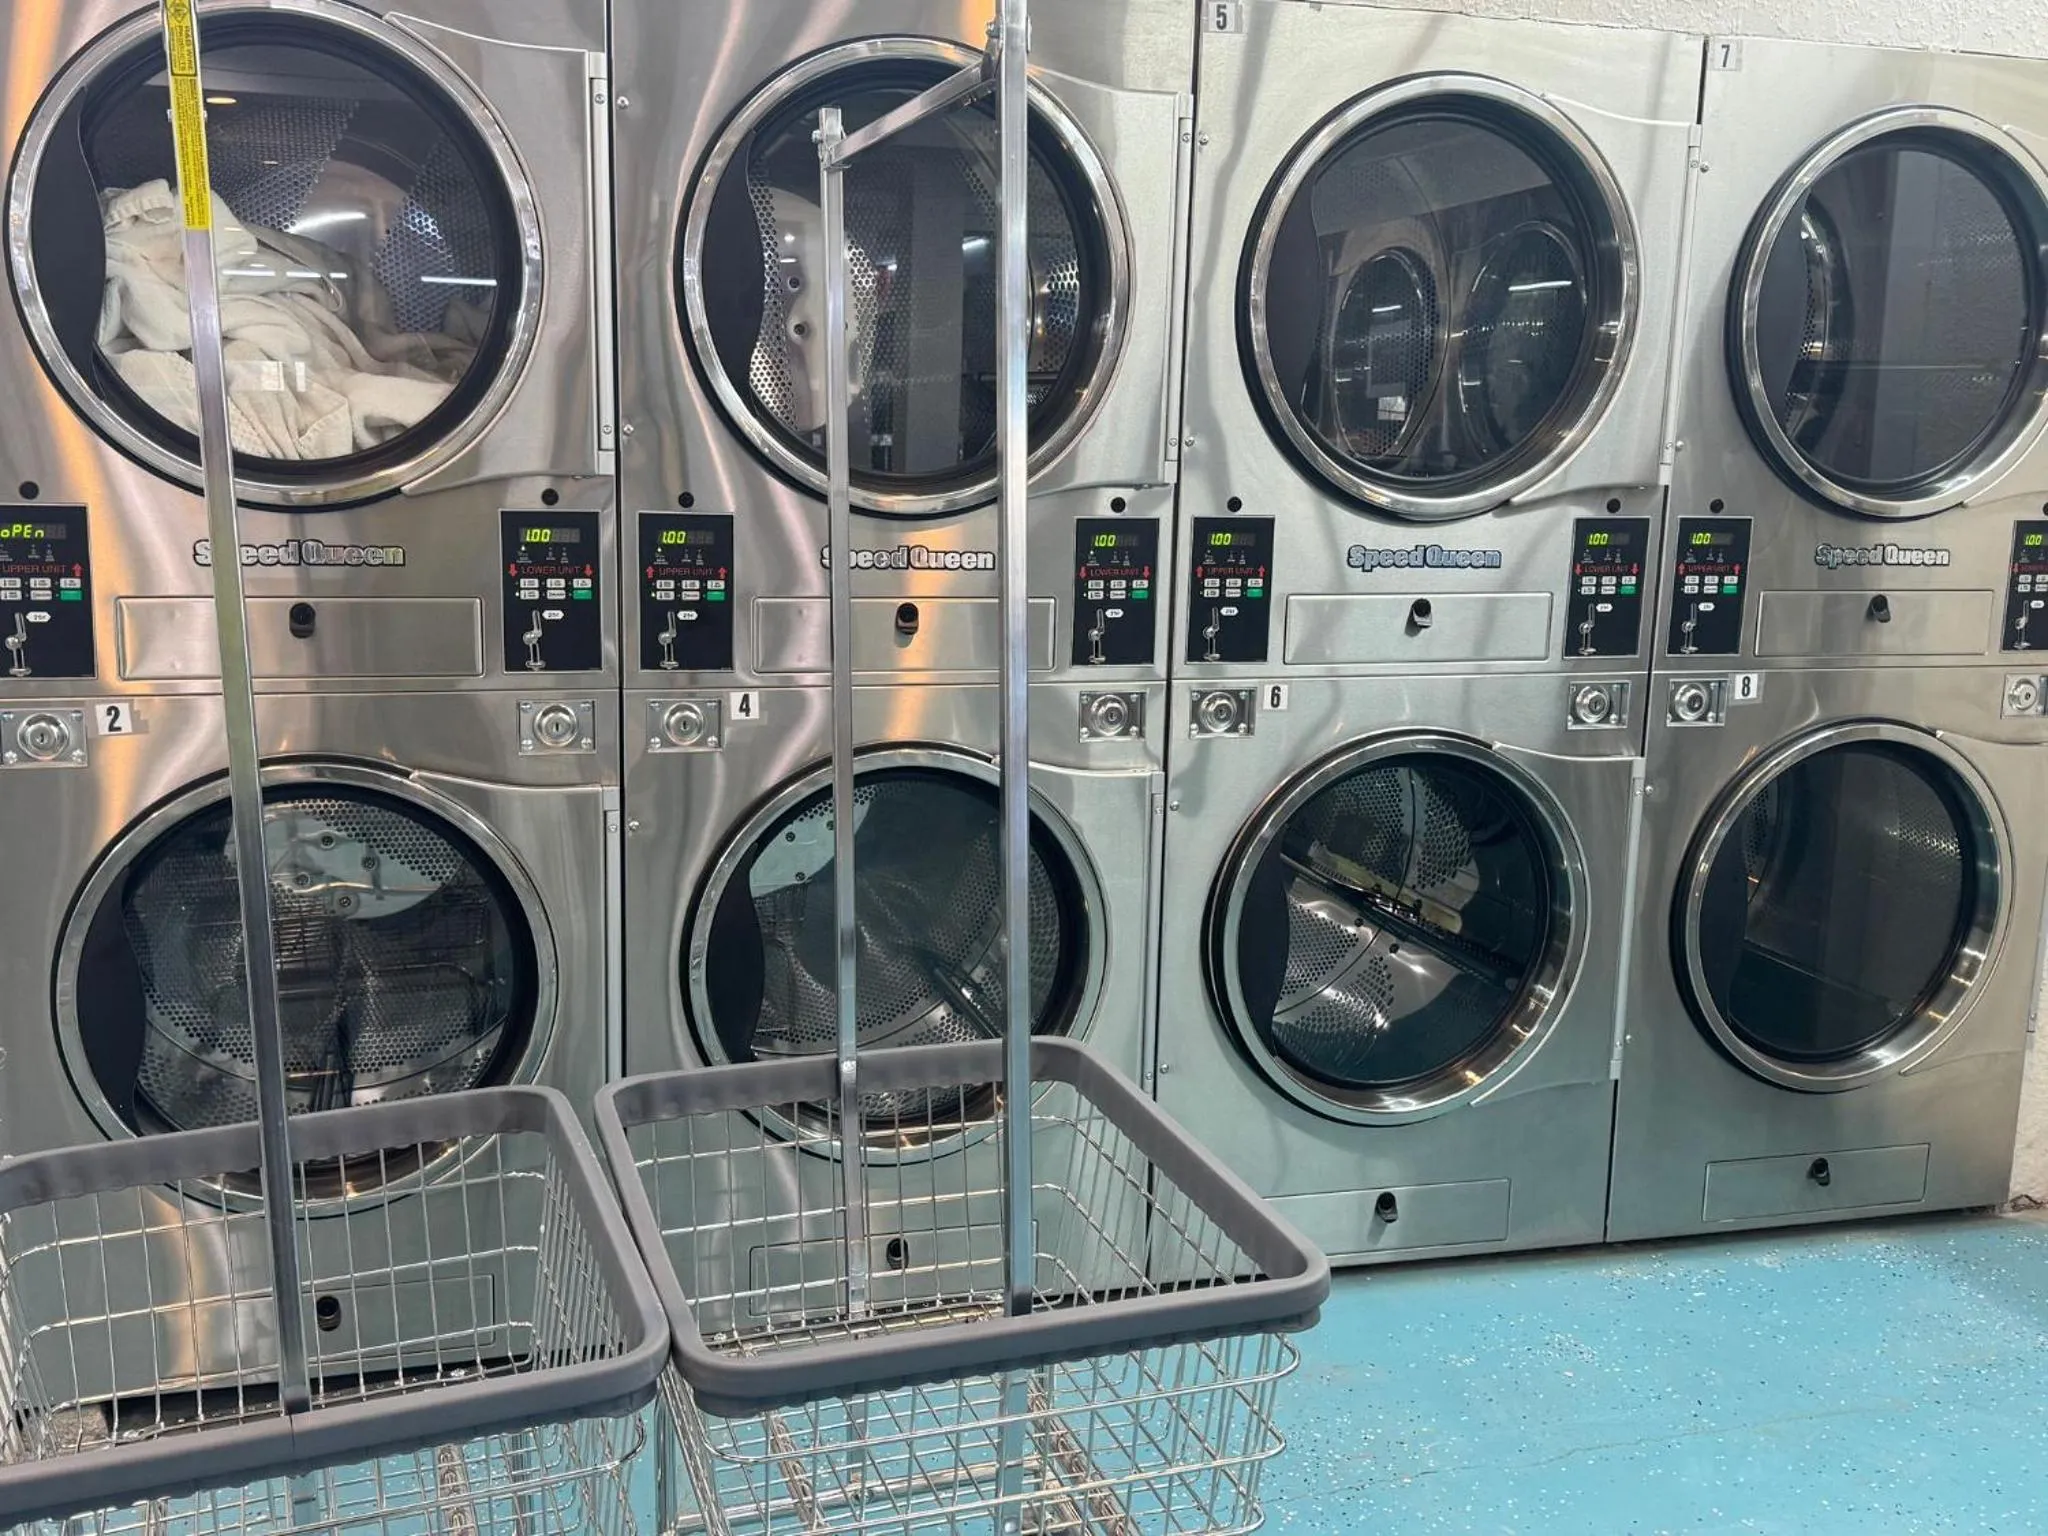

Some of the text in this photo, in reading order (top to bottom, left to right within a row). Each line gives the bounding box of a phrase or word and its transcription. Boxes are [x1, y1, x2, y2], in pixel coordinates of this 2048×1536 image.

[1216, 3, 1227, 30] 5
[1721, 44, 1730, 67] 7
[193, 539, 405, 567] Seed Queen
[909, 545, 996, 570] Queen
[1347, 544, 1502, 572] Speed Queen
[1814, 543, 1950, 569] Speed Queen
[521, 566, 580, 575] LOWER UNIT
[659, 567, 714, 576] UPPER UNIT
[1270, 685, 1281, 708] 6
[1741, 676, 1751, 697] 8
[738, 693, 751, 717] 4
[106, 705, 122, 732] 2
